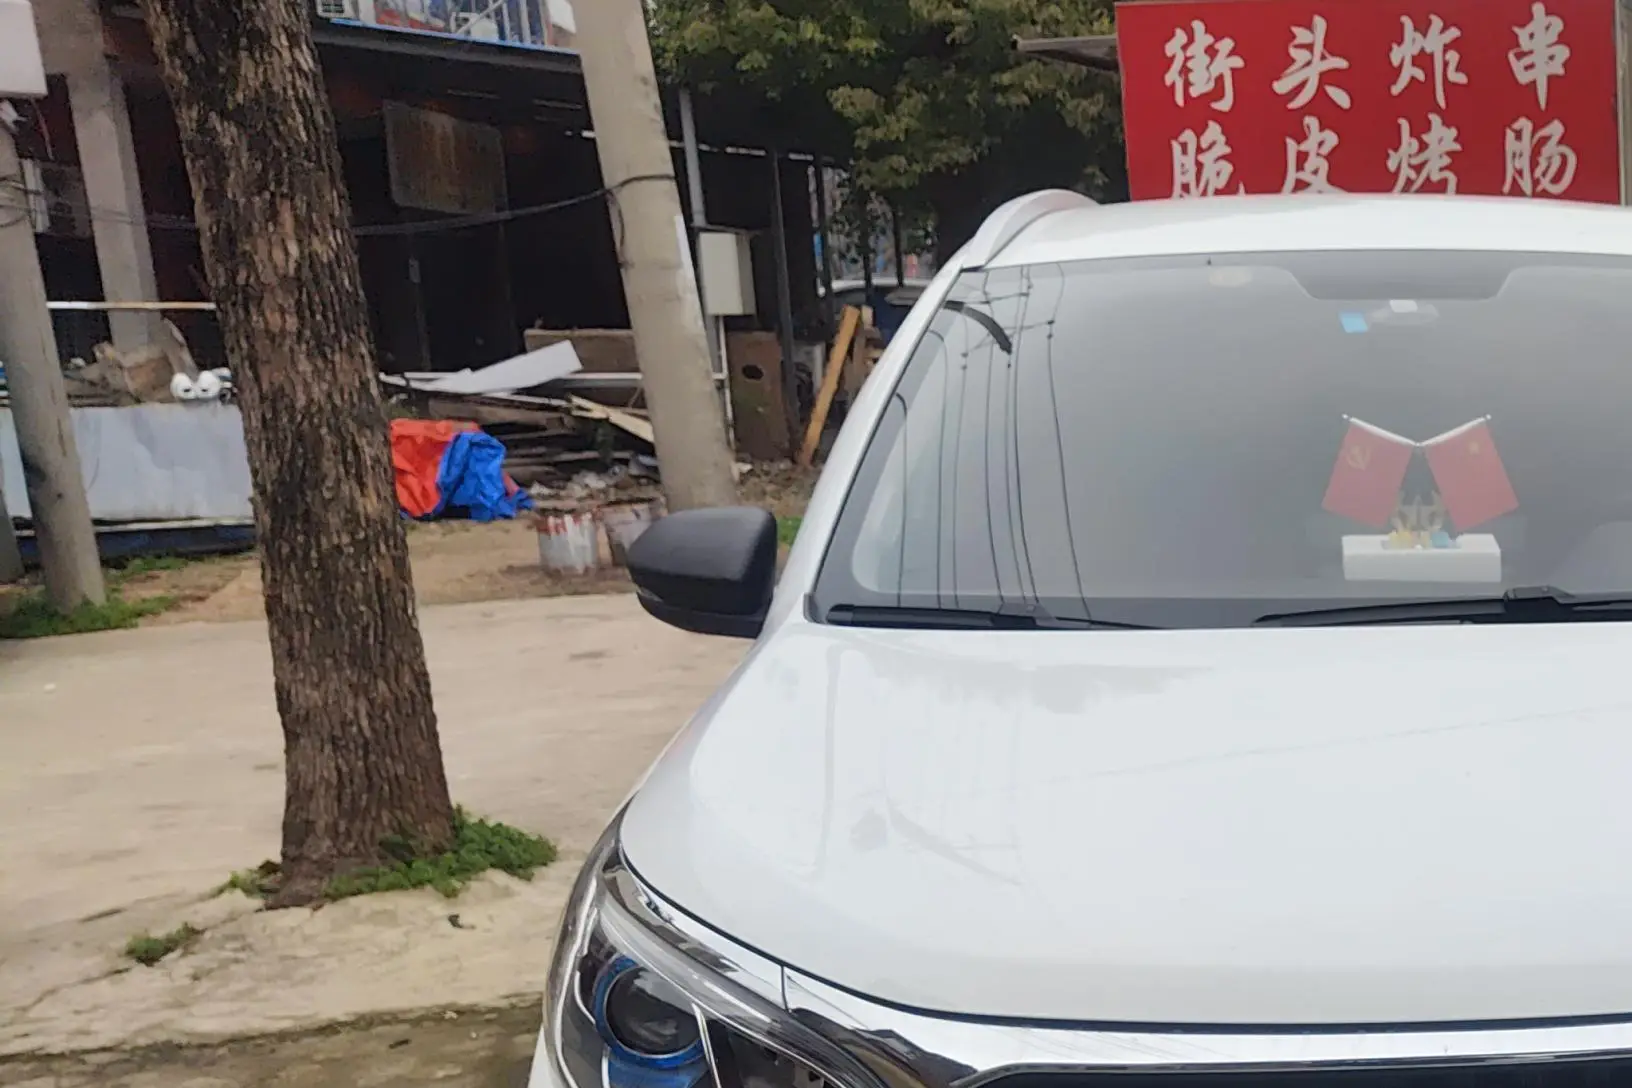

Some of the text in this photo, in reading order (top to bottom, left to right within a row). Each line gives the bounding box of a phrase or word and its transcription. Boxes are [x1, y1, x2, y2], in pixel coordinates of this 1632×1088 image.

[1164, 2, 1572, 112] 街头炸串
[1167, 113, 1578, 199] 脆皮烤肠
